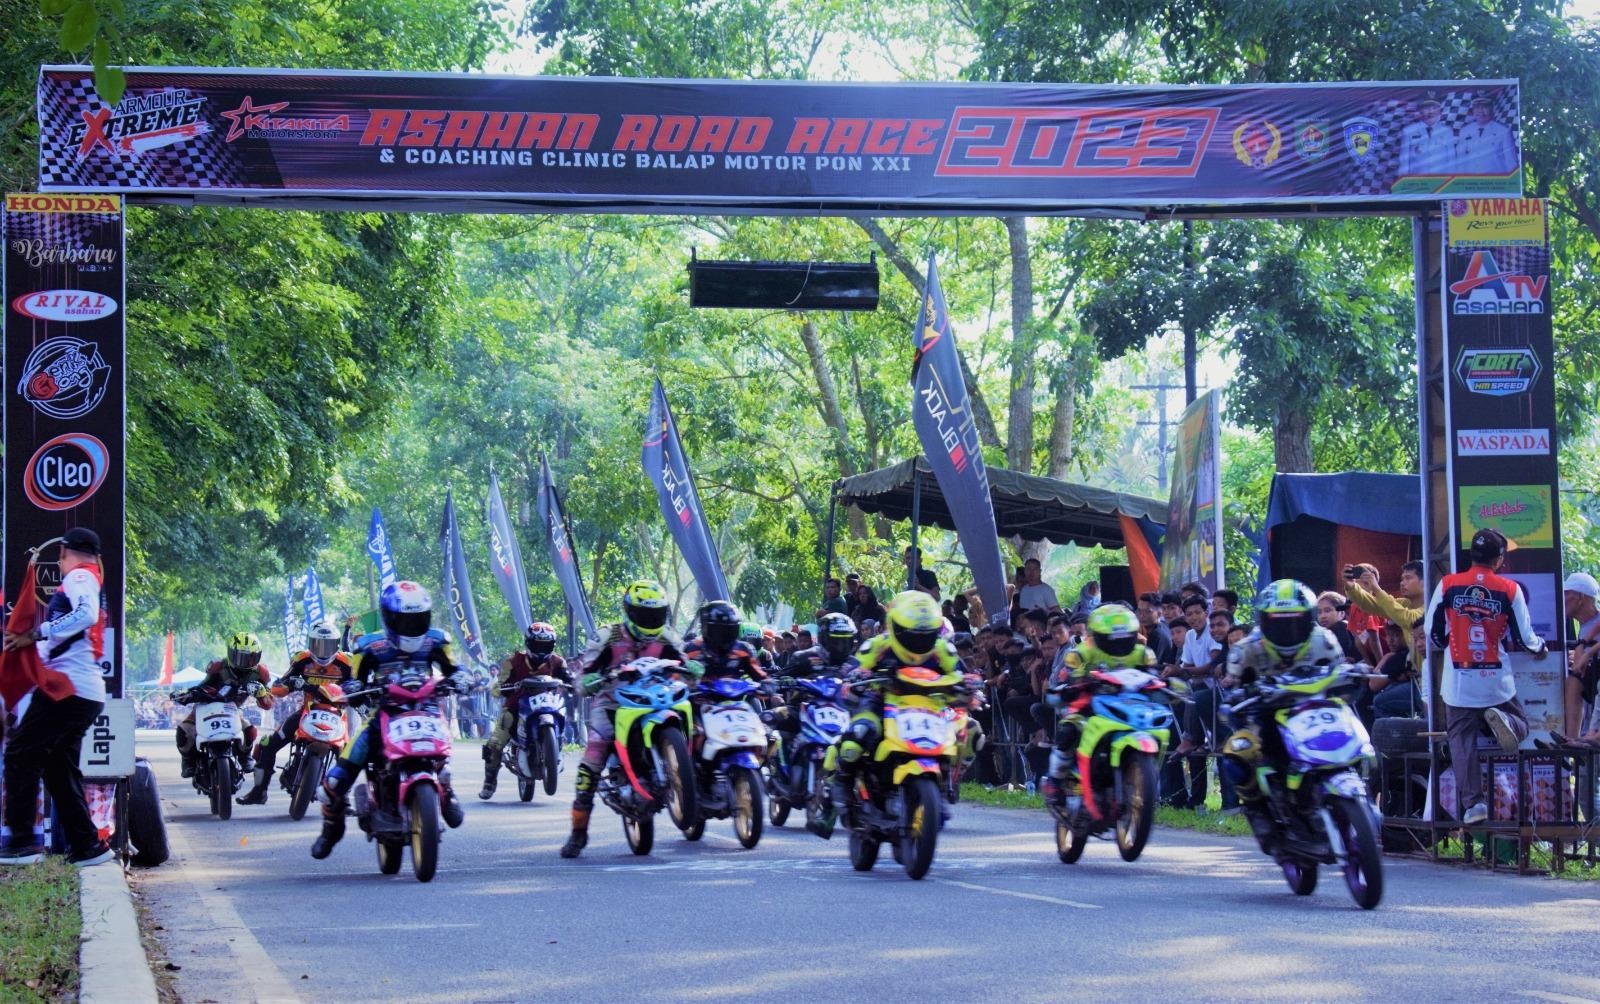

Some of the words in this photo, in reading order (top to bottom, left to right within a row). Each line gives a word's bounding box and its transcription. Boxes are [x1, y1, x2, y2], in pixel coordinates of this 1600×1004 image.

[114, 89, 187, 114] ARMOUR
[64, 101, 203, 161] EXTREME
[248, 130, 339, 139] MOTORSPORT
[359, 108, 601, 150] ASAHAN
[612, 114, 774, 153] ROAD
[785, 117, 946, 155] RACE
[940, 110, 1215, 172] 2023
[379, 148, 395, 164] &
[405, 149, 533, 166] COACHING
[542, 151, 626, 168] CLINIC
[636, 153, 715, 169] BALAP
[725, 154, 806, 171] MOTOR
[815, 156, 863, 171] PON
[872, 156, 911, 172] XXI
[8, 197, 118, 212] HONDA
[1471, 198, 1542, 216] YAMAHA
[12, 239, 117, 267] Barbara
[35, 295, 106, 307] RIVAL
[1455, 300, 1543, 314] ASAHAN
[65, 307, 102, 315] asahan
[1491, 382, 1524, 390] SPEED
[1458, 435, 1549, 450] WASPADA
[42, 457, 92, 487] Cleo
[210, 719, 231, 730] 93
[395, 719, 438, 733] 193
[88, 714, 116, 766] Laps
